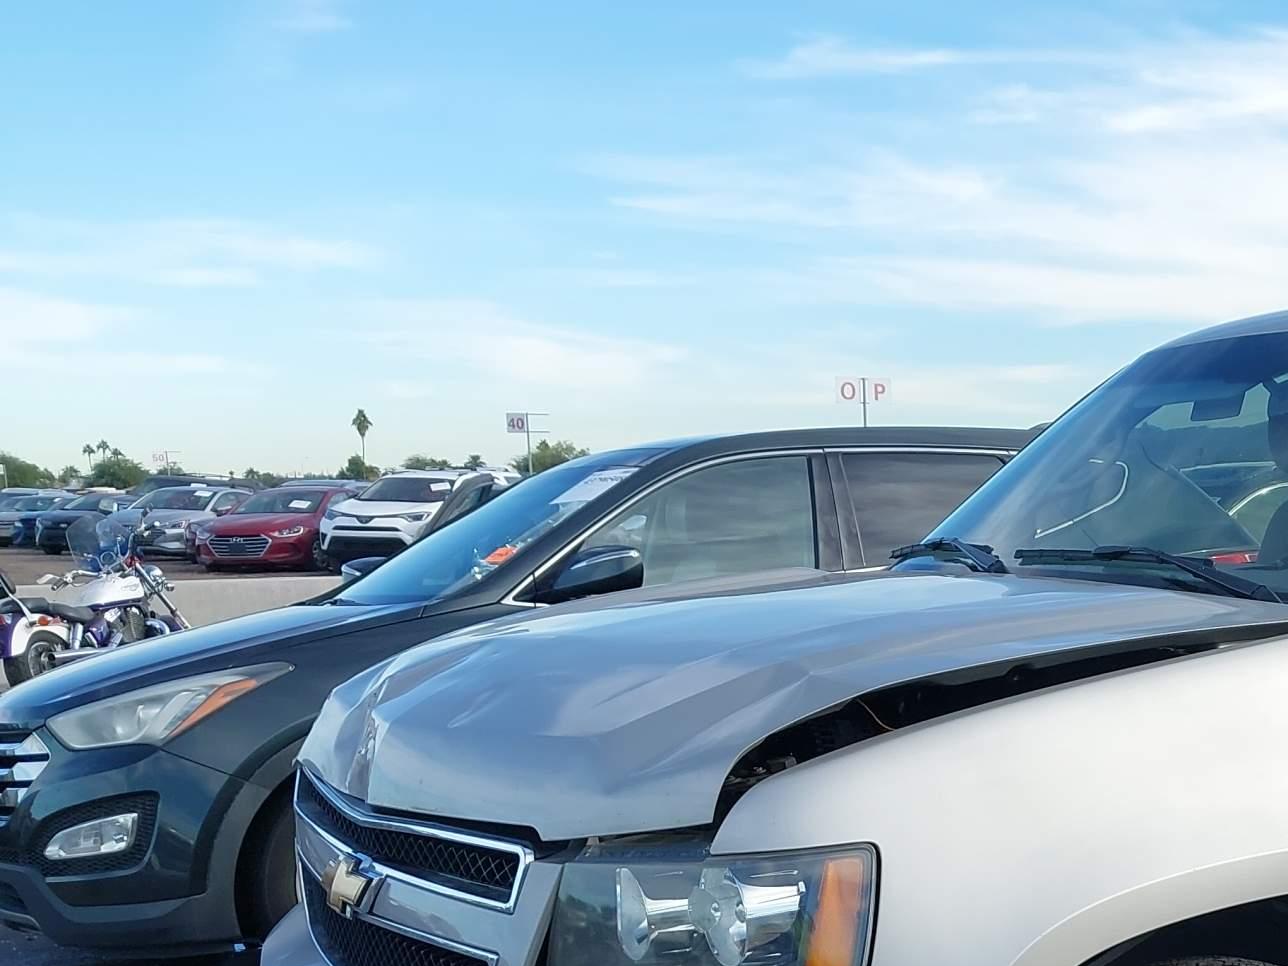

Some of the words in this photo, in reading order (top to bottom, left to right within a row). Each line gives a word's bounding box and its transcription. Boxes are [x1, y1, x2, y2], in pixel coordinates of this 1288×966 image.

[873, 383, 886, 401] P
[508, 417, 525, 430] 40
[152, 453, 165, 462] 50
